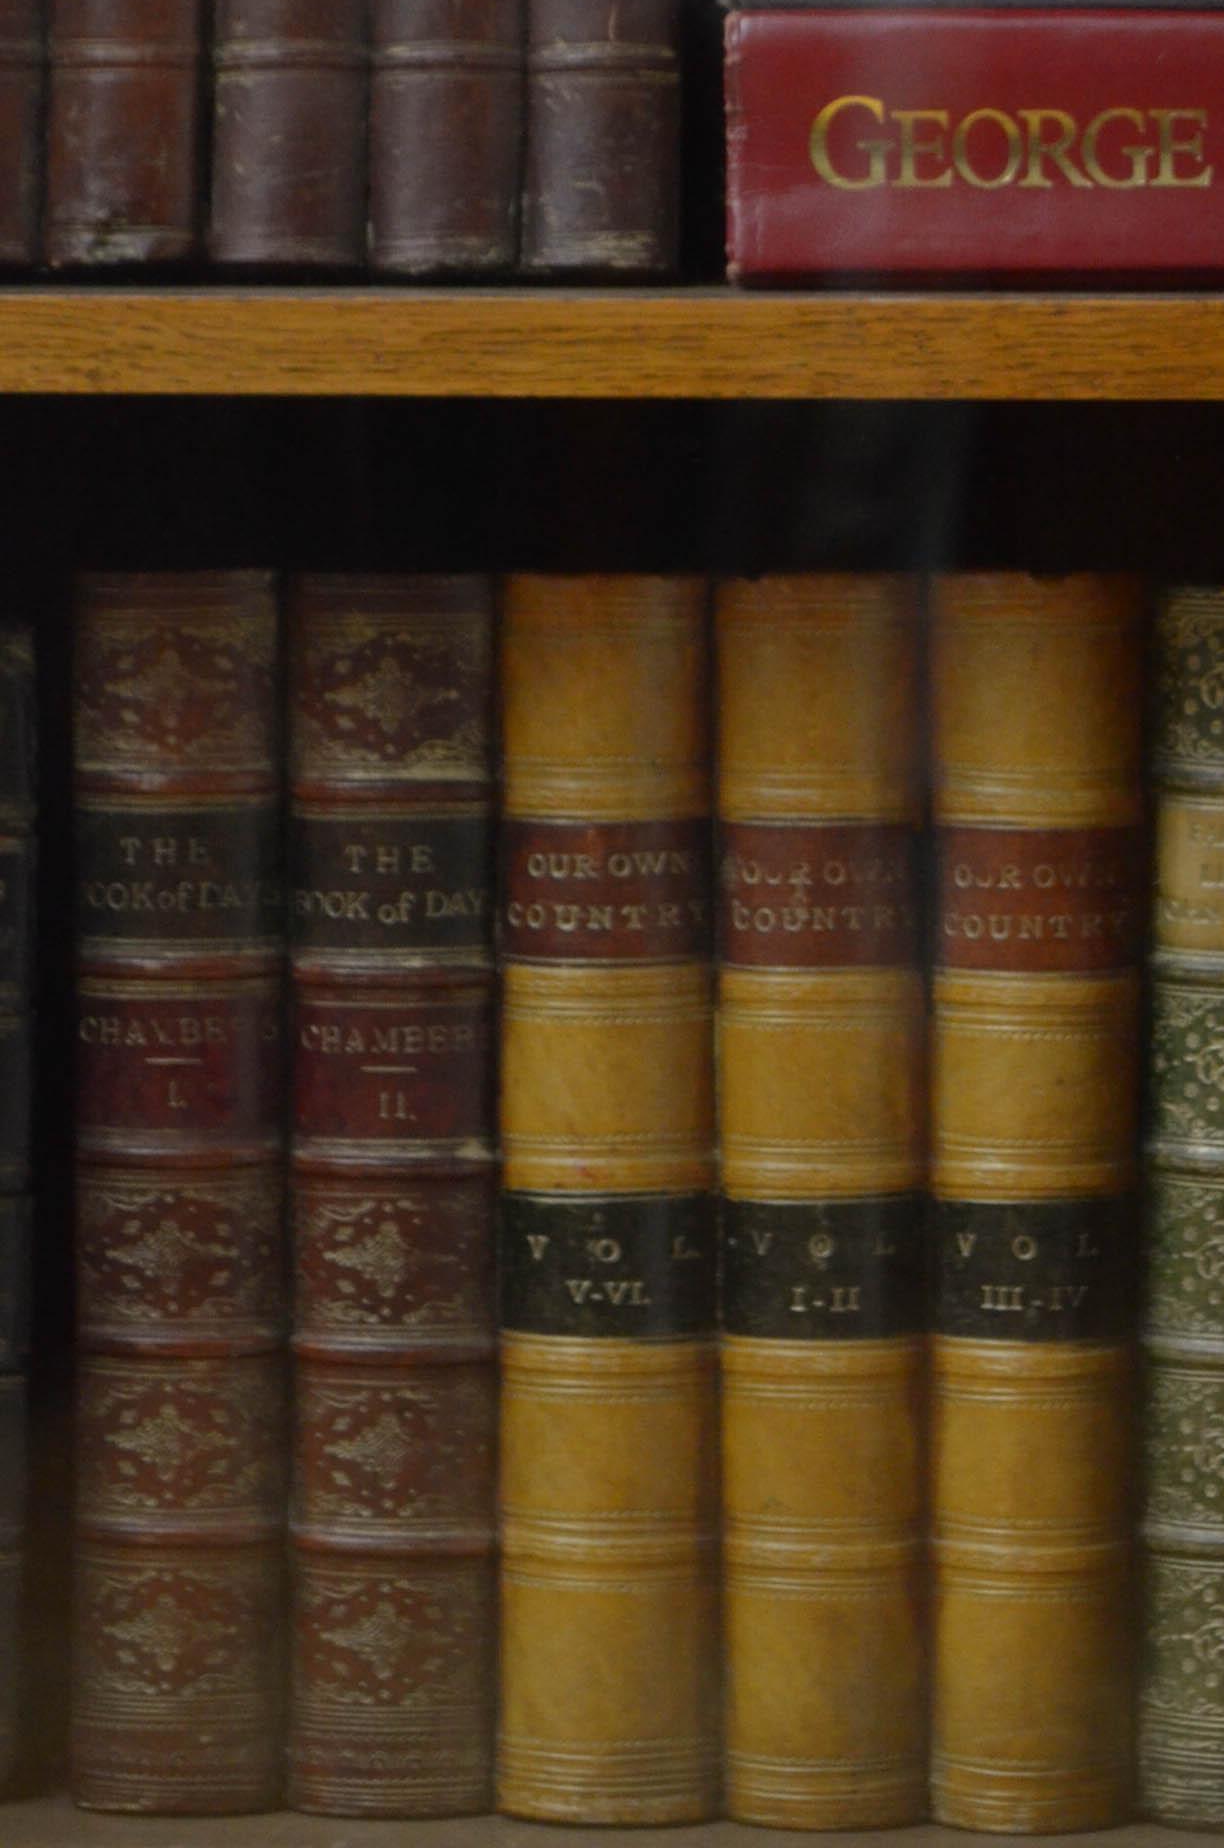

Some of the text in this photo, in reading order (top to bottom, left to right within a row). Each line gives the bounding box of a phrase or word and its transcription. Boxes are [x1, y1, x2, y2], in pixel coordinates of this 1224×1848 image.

[808, 94, 1214, 190] GEORGE
[119, 836, 209, 866] THE
[343, 843, 436, 875] THE
[526, 851, 689, 879] OUR OWN
[953, 863, 1115, 890] OUR OW
[82, 880, 155, 912] OOK
[156, 880, 193, 912] of
[376, 889, 416, 926] of
[506, 900, 705, 932] COUNTRY
